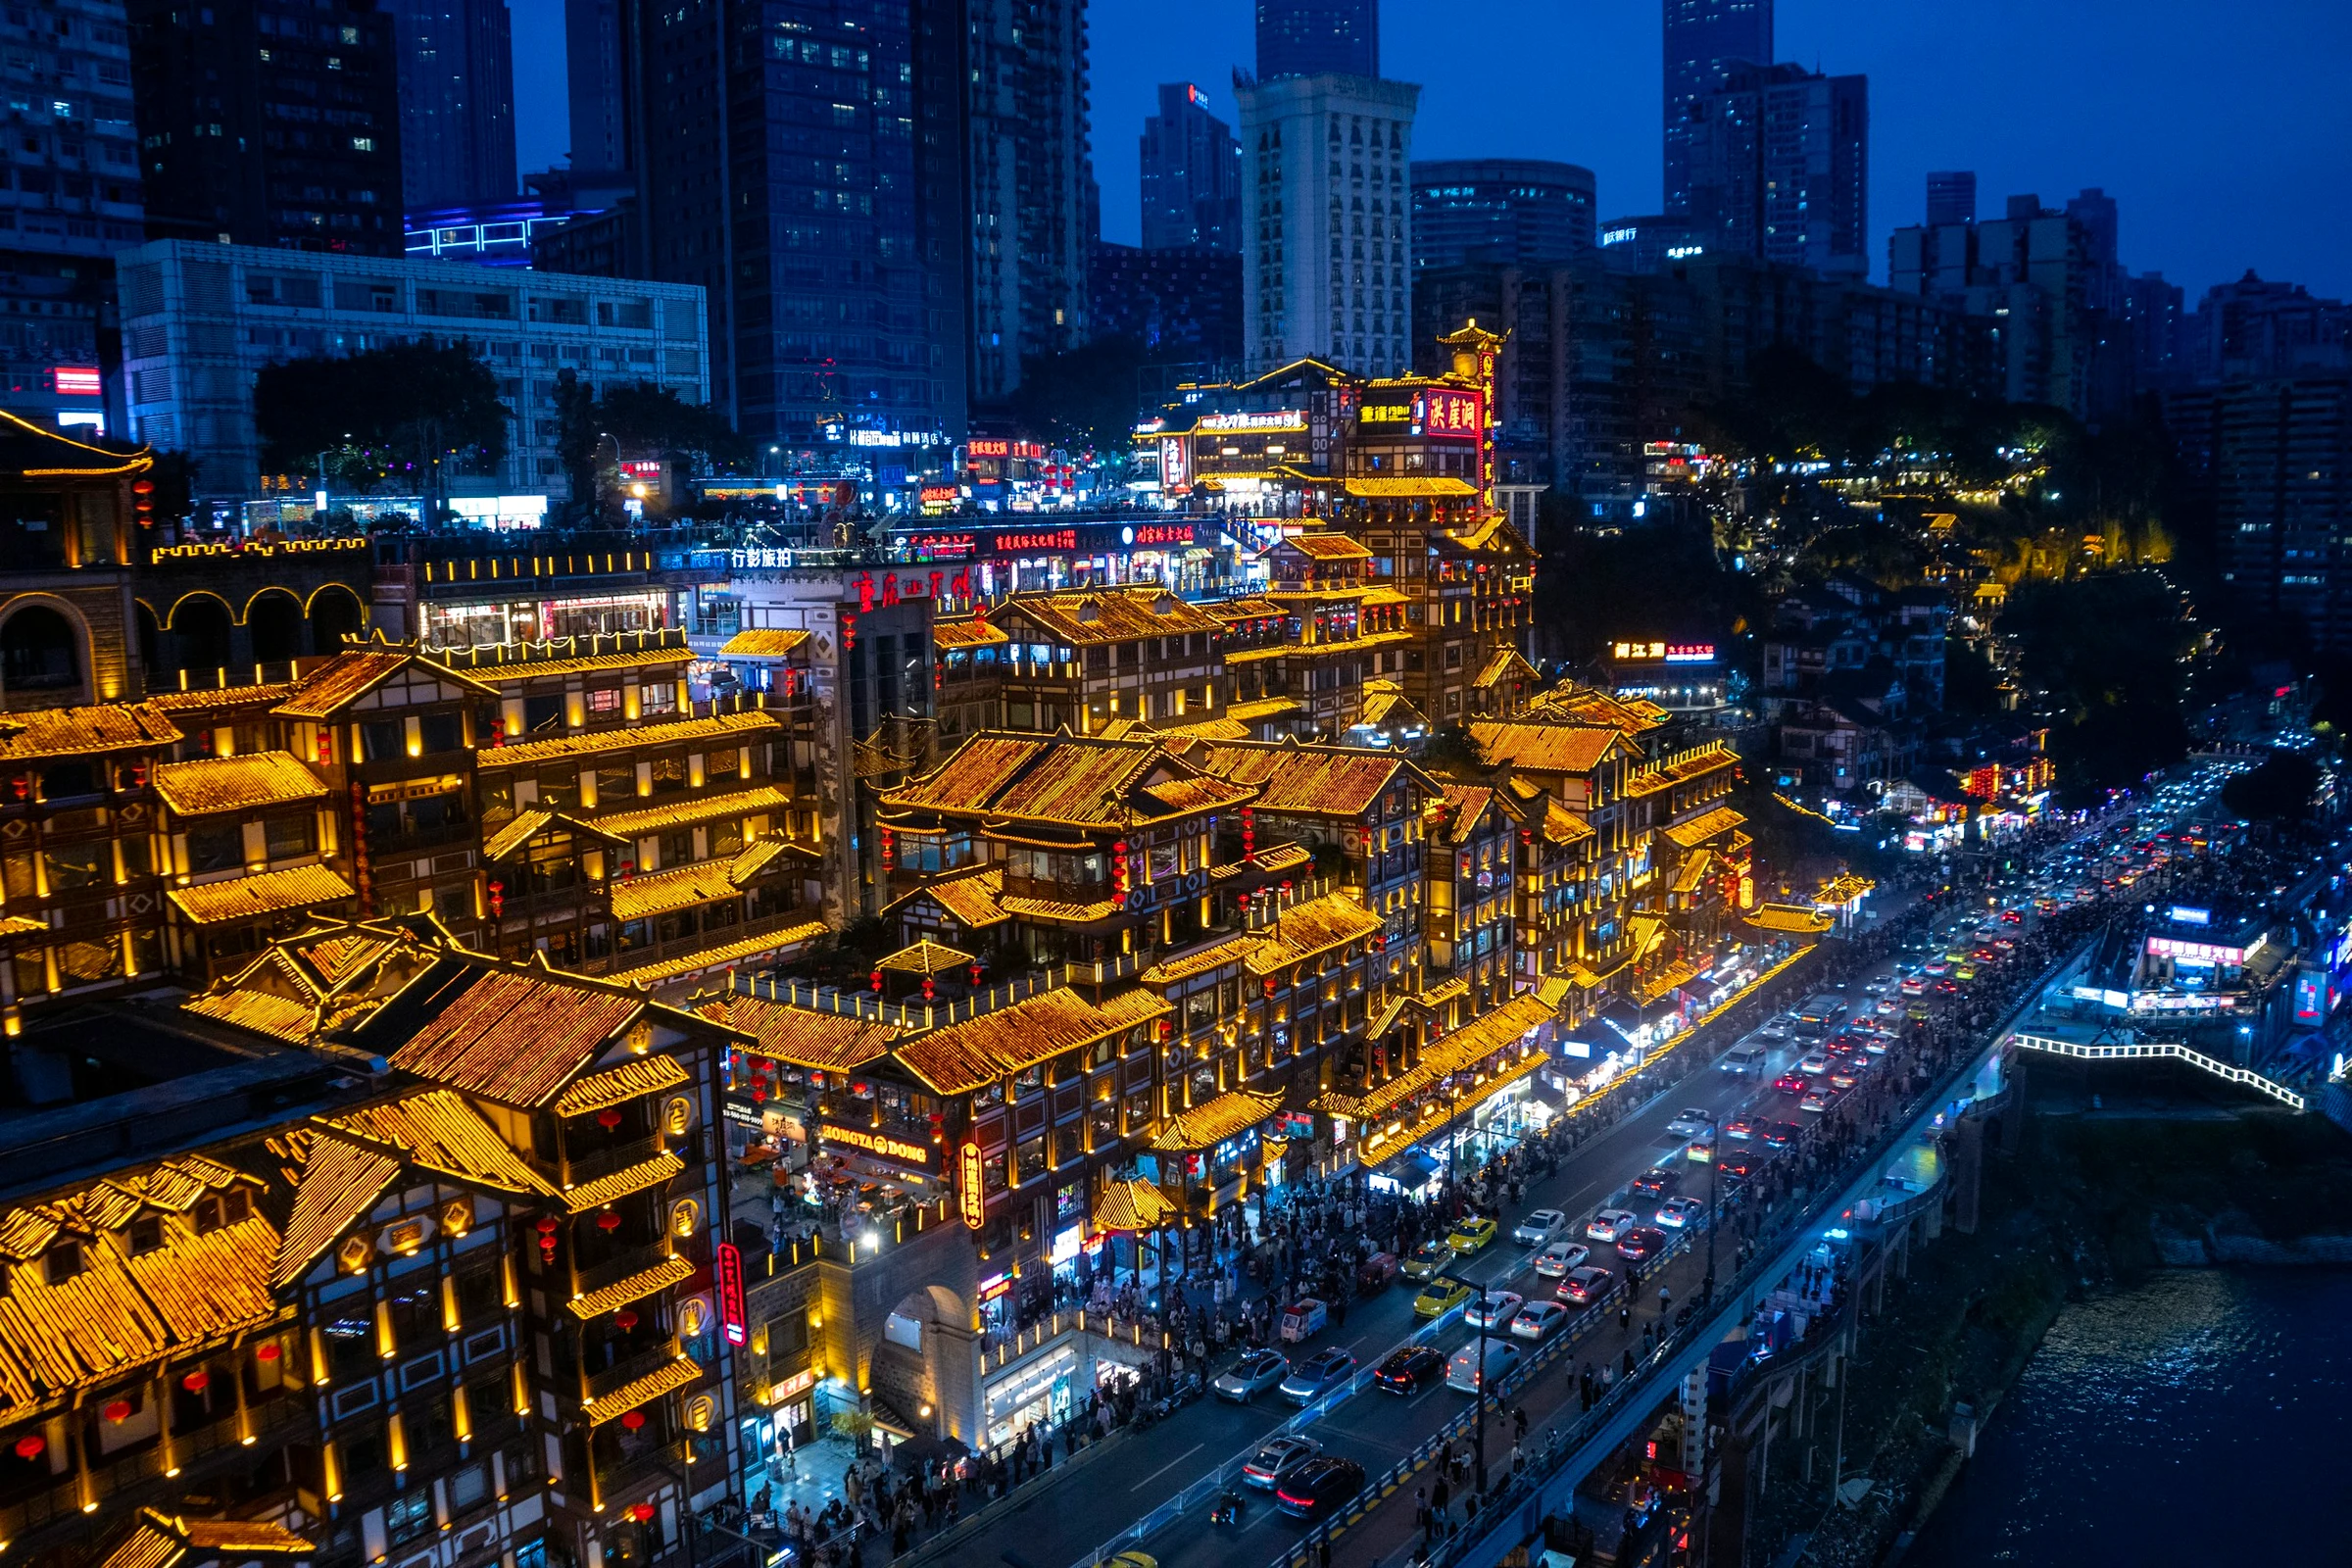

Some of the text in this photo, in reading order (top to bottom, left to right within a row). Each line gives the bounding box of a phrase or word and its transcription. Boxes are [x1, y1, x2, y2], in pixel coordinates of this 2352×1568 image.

[1430, 396, 1476, 430] 洪崖洞
[732, 548, 792, 568] 行影旅拍
[822, 1125, 927, 1163] HONGYA DONG
